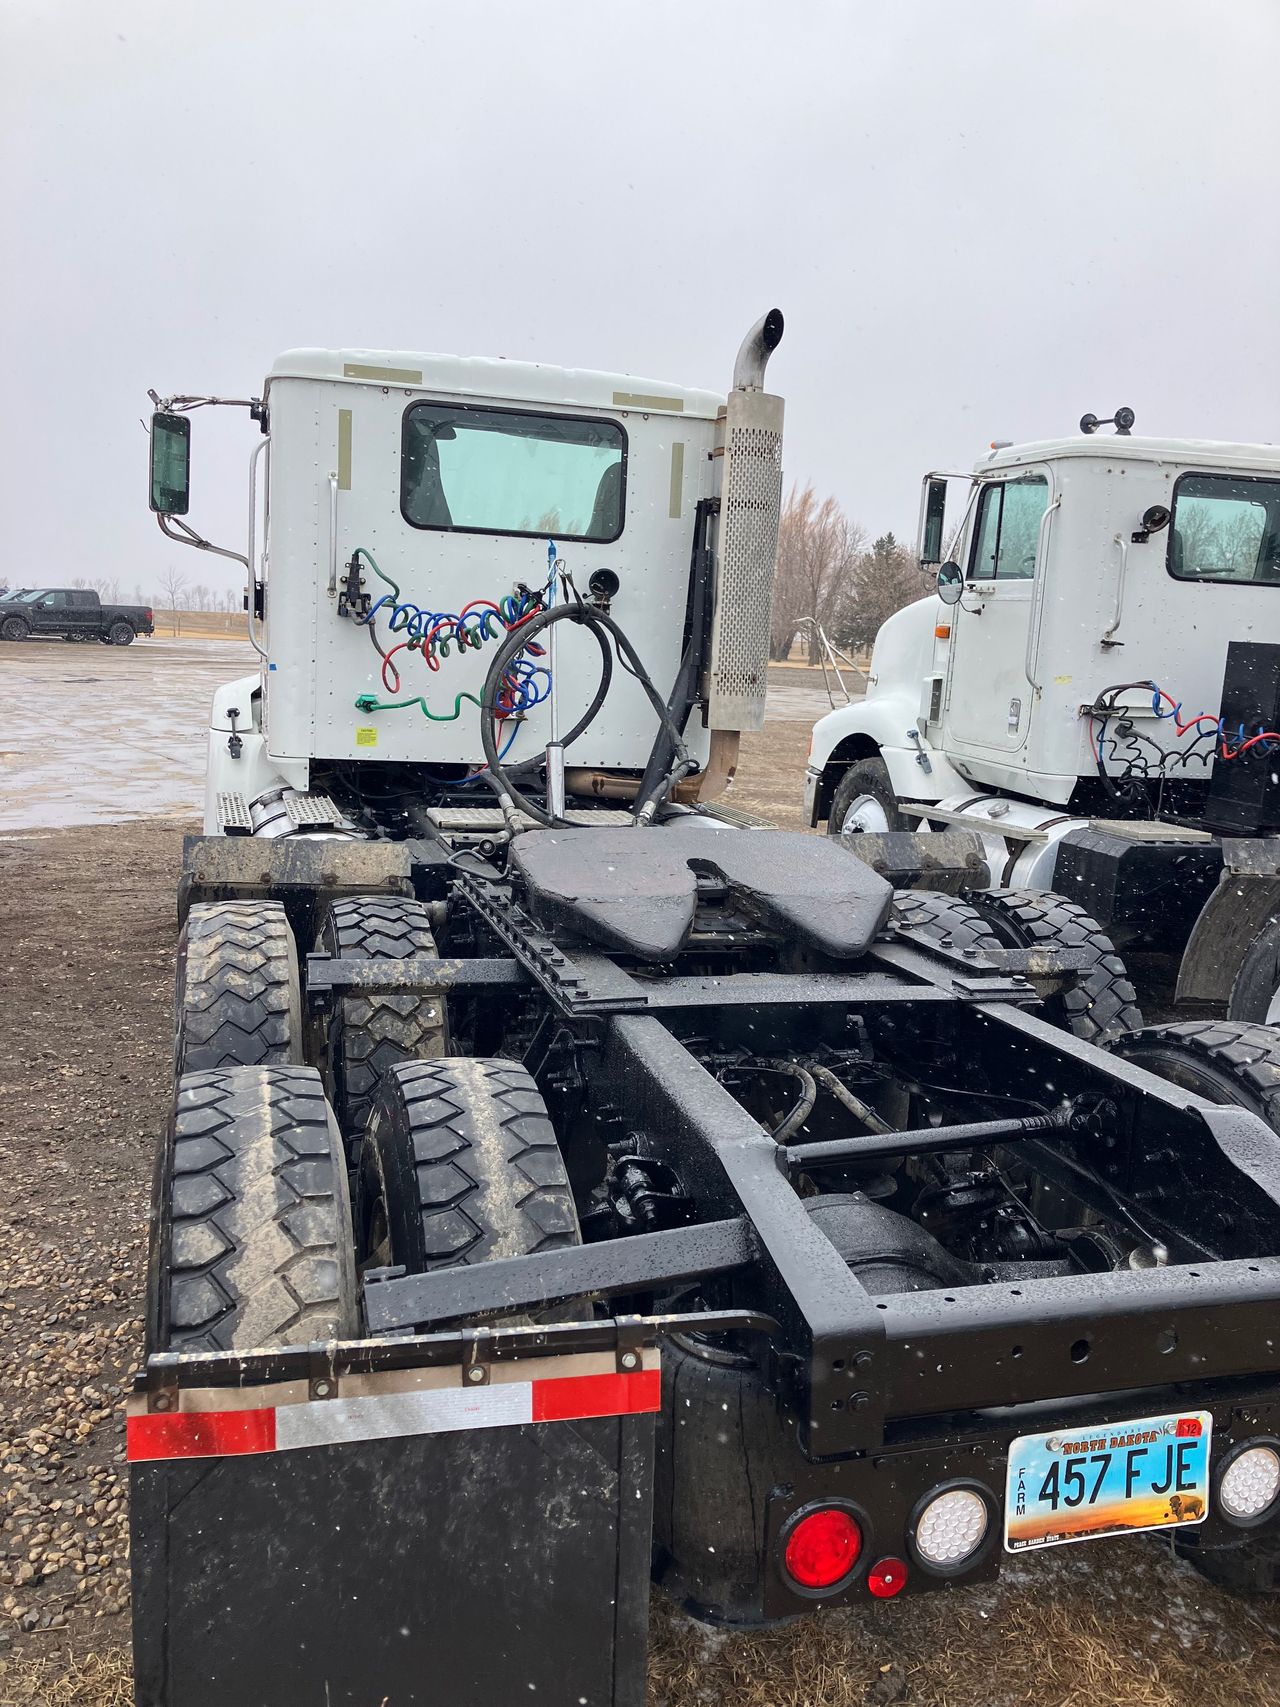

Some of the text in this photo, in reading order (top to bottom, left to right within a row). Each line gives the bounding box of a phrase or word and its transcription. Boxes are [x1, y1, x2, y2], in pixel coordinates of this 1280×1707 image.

[1062, 1430, 1158, 1455] NORTH DAKOTA
[1016, 1467, 1027, 1516] FARM
[1038, 1453, 1113, 1511] 457
